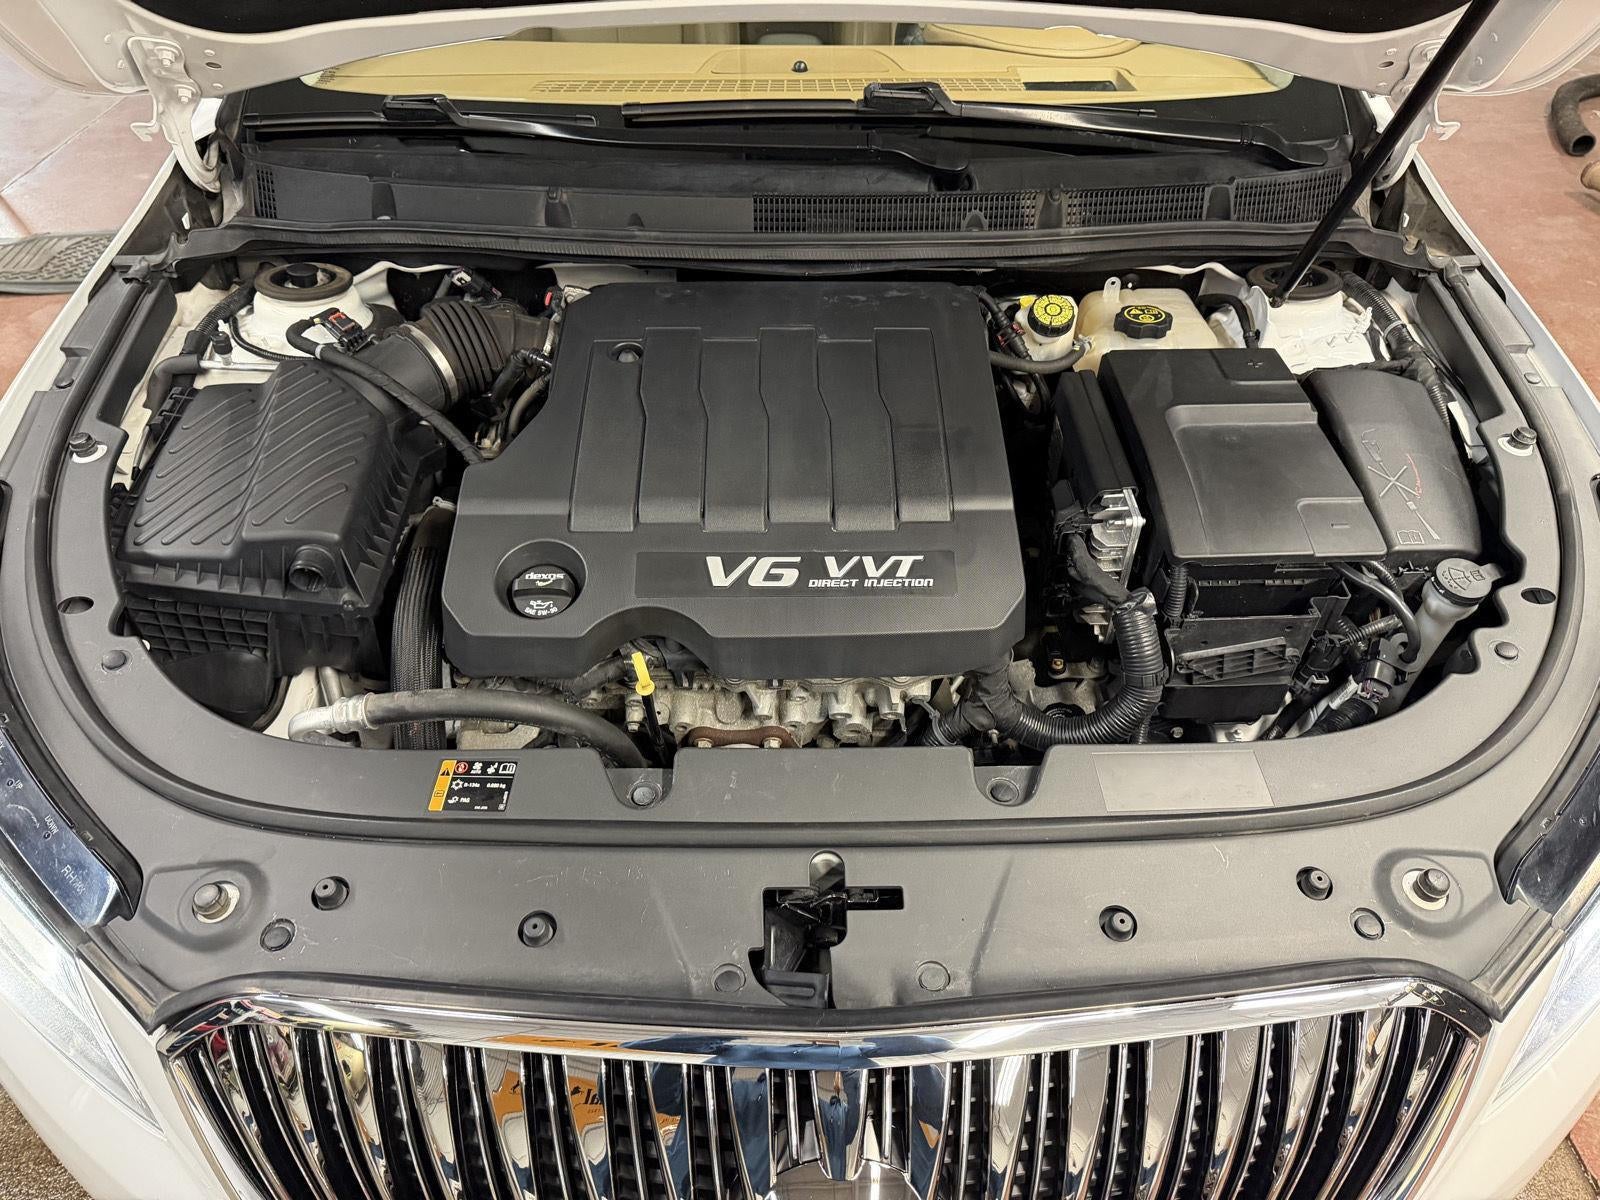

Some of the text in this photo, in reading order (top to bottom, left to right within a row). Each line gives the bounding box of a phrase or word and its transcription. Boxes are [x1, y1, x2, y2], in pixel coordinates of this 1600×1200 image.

[525, 572, 565, 580] dexos
[705, 555, 925, 588] V6 VVT
[808, 578, 934, 588] DIRECT INJECTION
[524, 607, 558, 615] SAE 5W-30
